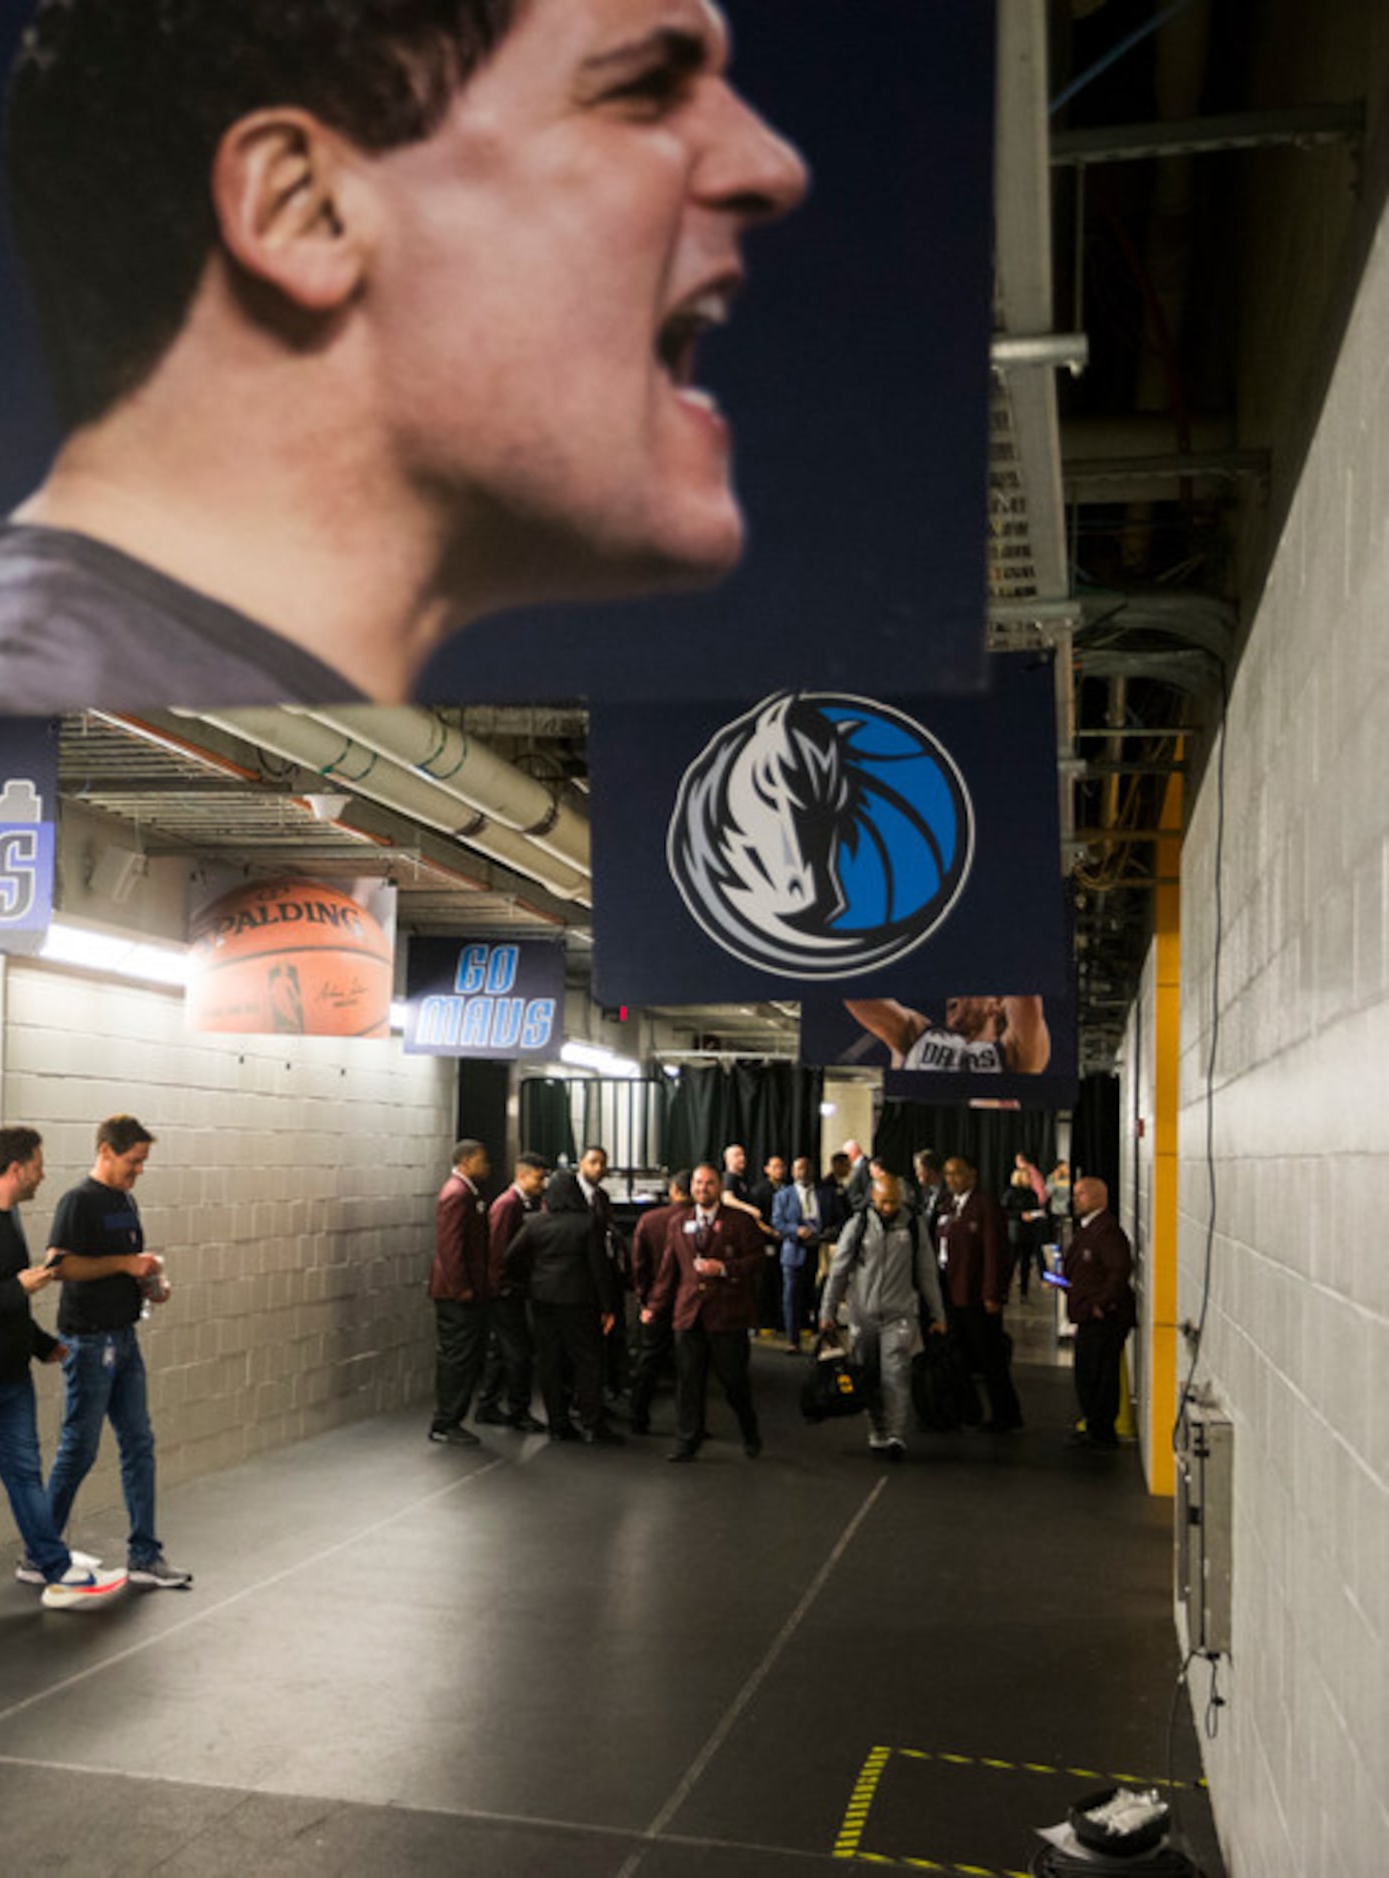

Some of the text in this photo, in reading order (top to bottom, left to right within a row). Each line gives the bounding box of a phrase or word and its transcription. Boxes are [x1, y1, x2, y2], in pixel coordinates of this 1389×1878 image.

[207, 901, 364, 945] PALDING
[455, 944, 519, 995] GO
[415, 996, 556, 1048] MAVS
